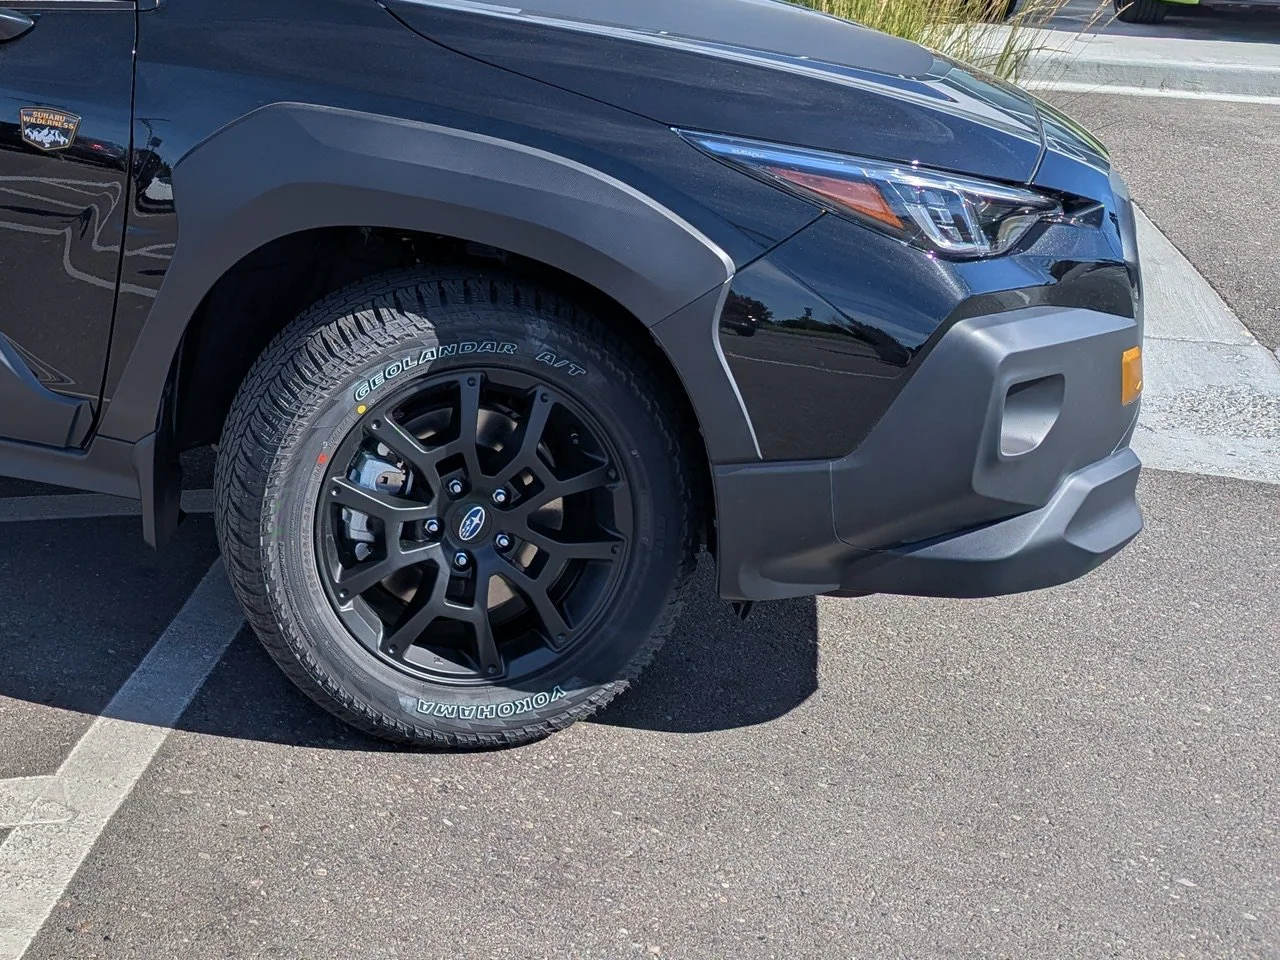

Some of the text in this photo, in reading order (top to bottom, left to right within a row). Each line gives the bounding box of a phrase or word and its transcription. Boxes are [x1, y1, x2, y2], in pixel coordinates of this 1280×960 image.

[23, 115, 74, 130] WILDERNESS
[33, 111, 66, 122] SUBARU
[354, 341, 587, 402] GEOLANDAR A/T
[417, 685, 567, 719] YOKOHAMA
